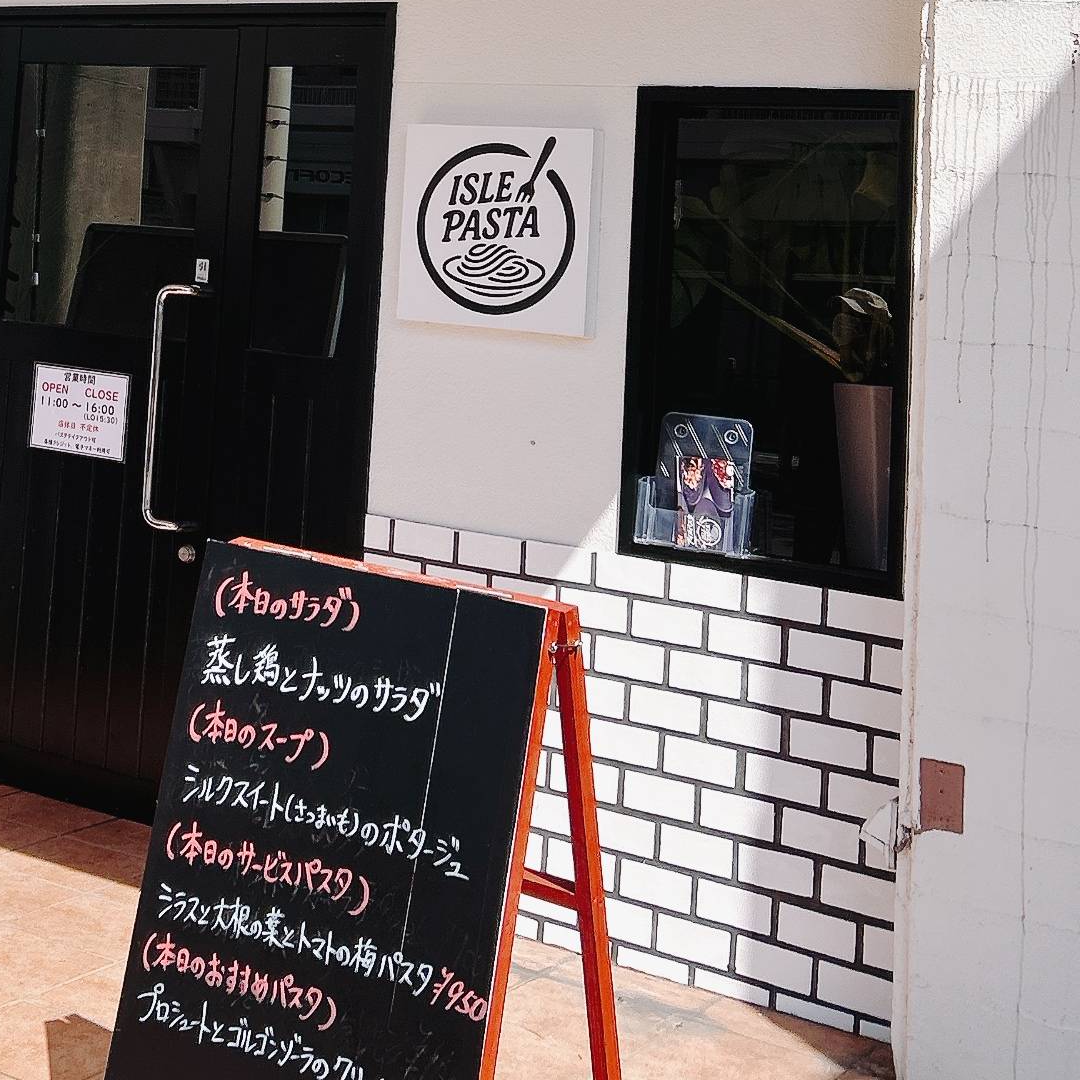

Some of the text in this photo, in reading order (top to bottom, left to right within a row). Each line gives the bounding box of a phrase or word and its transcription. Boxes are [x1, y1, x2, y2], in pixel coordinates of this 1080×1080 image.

[448, 171, 515, 205] ISLE
[442, 206, 540, 242] PASTA
[41, 395, 68, 408] 11:00
[86, 402, 115, 415] 16:00
[42, 382, 119, 402] OPEN CLOSE
[64, 372, 96, 385] 営業時間
[214, 571, 360, 632] (本日のサラダ)
[201, 633, 441, 722] 蒸し鶏とナッツのサラダ
[187, 699, 330, 770] (本日のスープ)
[166, 821, 370, 916] (本日のサービスパスタ)
[143, 932, 337, 1030] (本日のおすすめパスタ)
[137, 982, 384, 1080] プロシュートとゴルゴンゾーラのクリ
